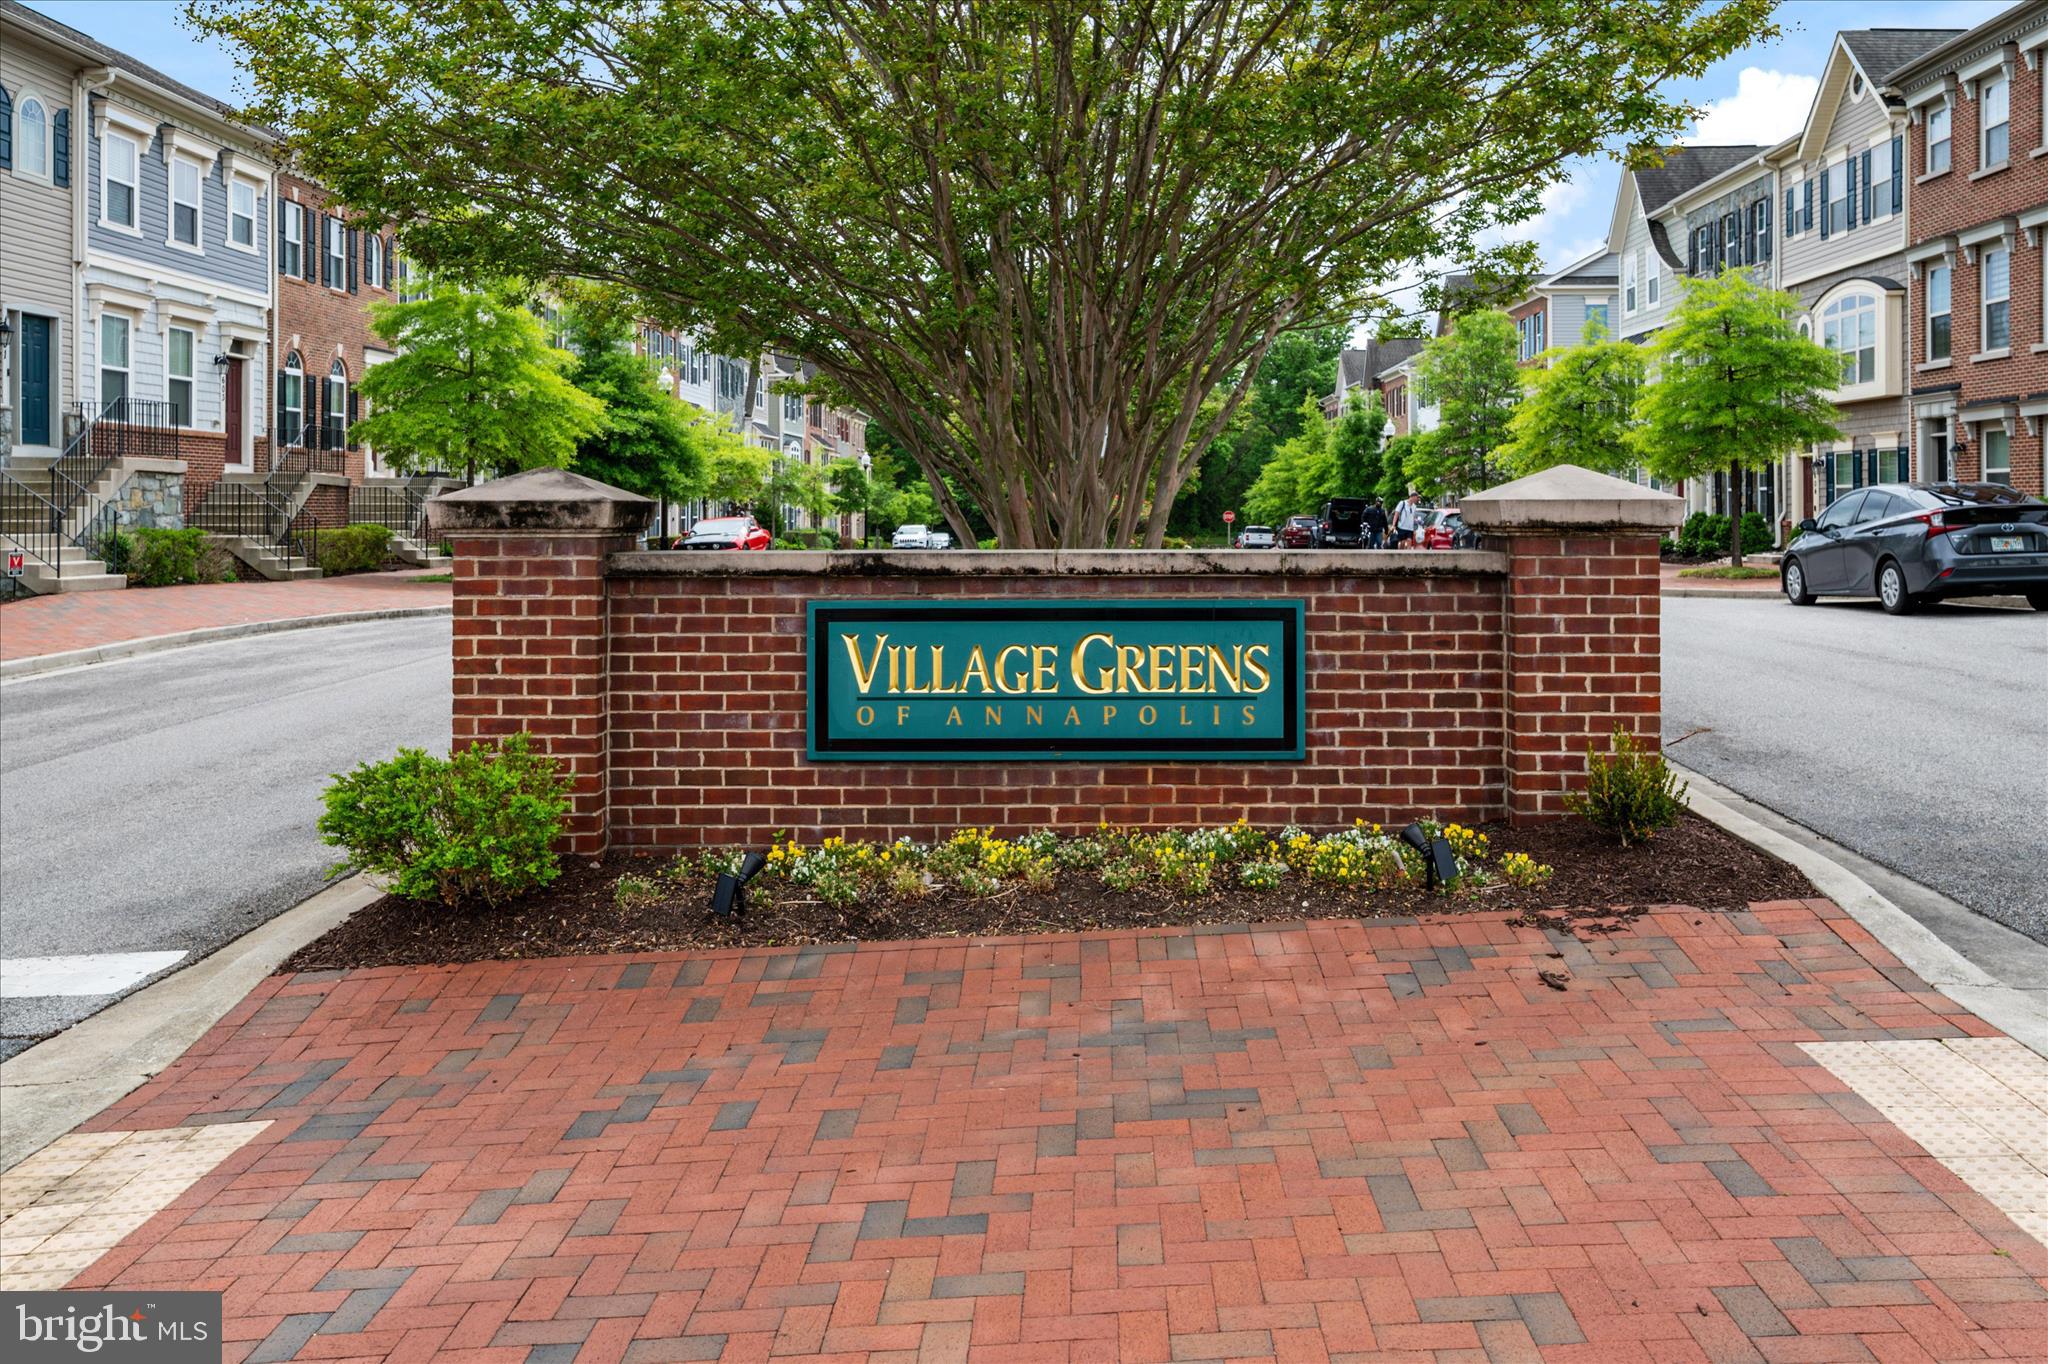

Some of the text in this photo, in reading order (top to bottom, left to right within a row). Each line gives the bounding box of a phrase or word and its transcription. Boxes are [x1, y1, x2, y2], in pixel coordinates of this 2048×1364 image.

[841, 632, 1271, 694] VILLAGE GREENS
[856, 705, 1256, 726] OF ANNAPOLIS
